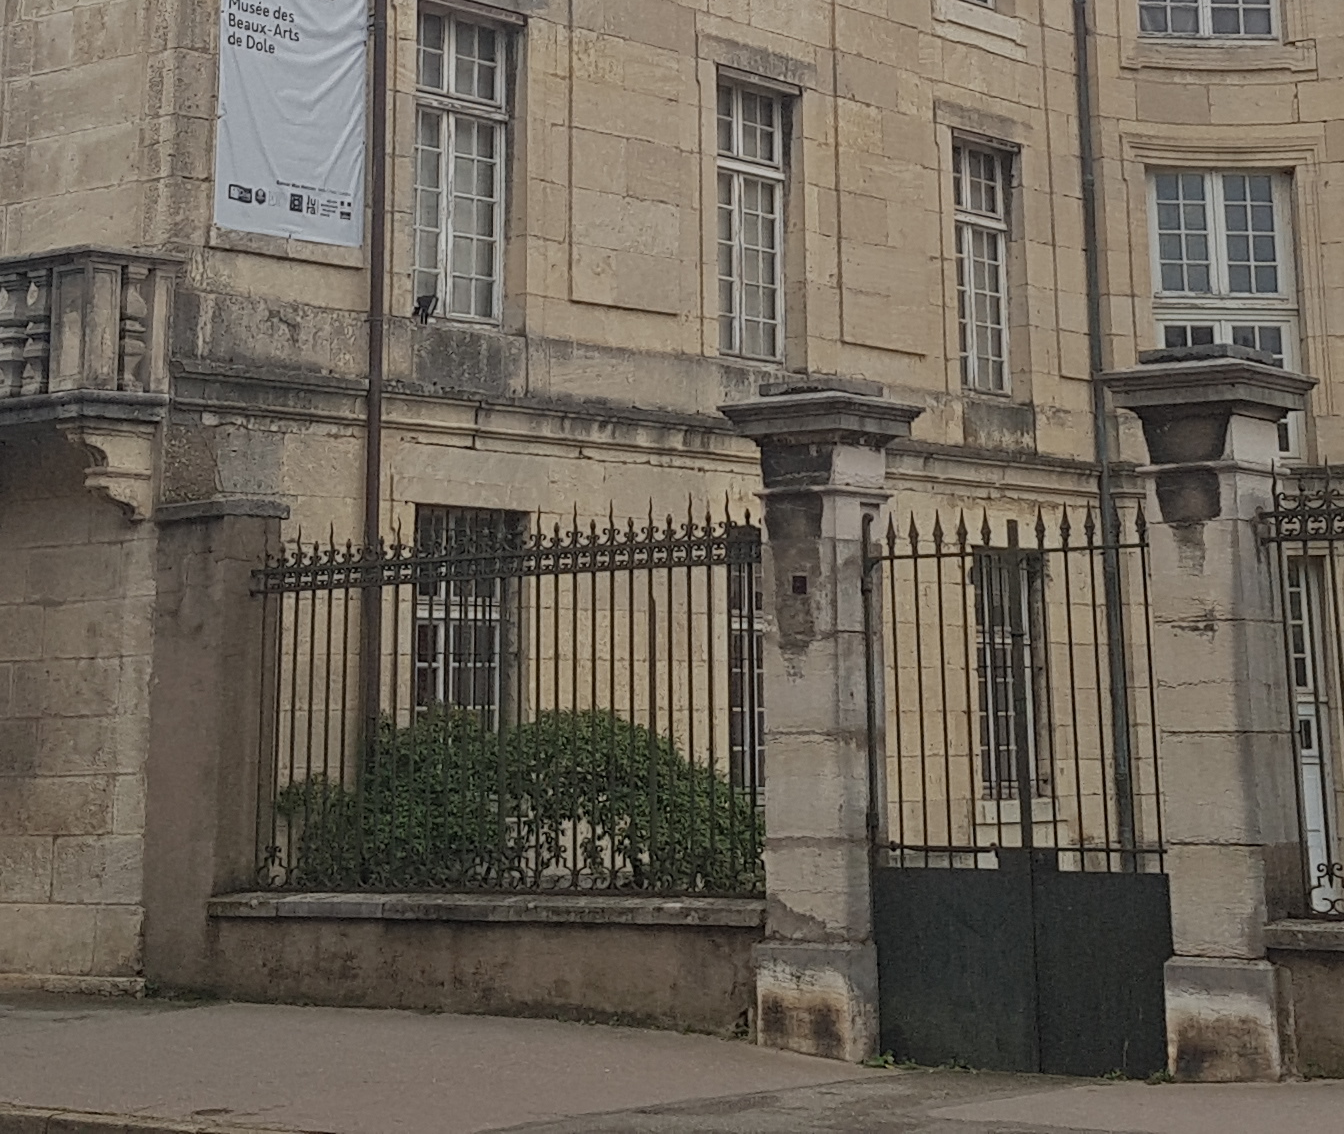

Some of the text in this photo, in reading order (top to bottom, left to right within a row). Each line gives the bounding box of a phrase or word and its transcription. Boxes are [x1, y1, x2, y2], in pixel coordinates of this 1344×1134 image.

[273, 6, 295, 23] des
[228, 12, 300, 42] Beaux-Arts
[227, 31, 276, 54] de Dole
